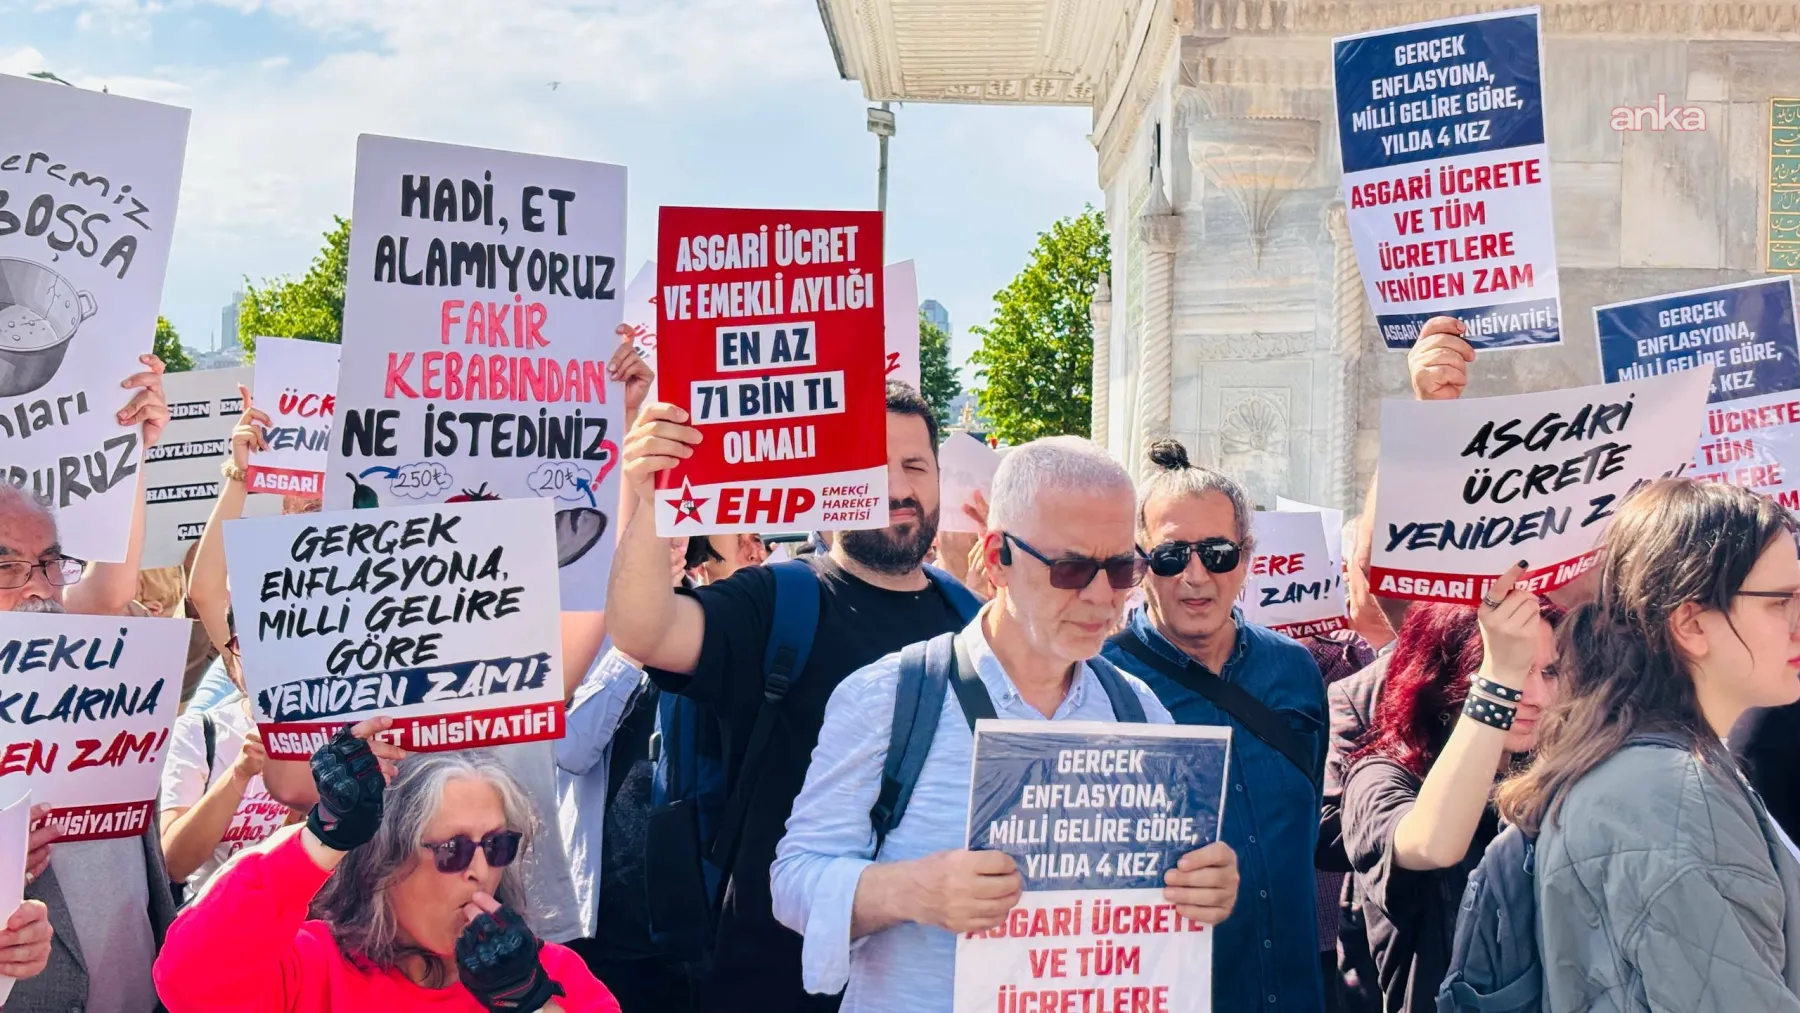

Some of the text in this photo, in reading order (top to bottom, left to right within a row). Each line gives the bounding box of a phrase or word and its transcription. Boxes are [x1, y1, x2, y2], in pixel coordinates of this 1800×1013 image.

[1394, 35, 1465, 67] GERÇEK
[1371, 62, 1495, 100] ENFLASYONA,
[1352, 86, 1524, 133] MİLLİ GELİRE GÖRE,
[1381, 119, 1491, 156] YILDA 4 KEZ
[401, 169, 576, 236] HADİ, ET
[1350, 158, 1541, 210] ASGARİ ÜCRETE
[1393, 196, 1486, 236] VE TÜM
[374, 234, 616, 300] ALAMIYORUZ
[675, 223, 859, 273] ASGARİ ÜCRET
[1378, 231, 1516, 271] ÜCRETLERE
[663, 268, 875, 321] VE EMEKLİ AYLIĞI
[1375, 263, 1534, 305] YENİDEN ZAM
[441, 293, 550, 349] FAKİR
[1658, 300, 1727, 328] GERÇEK
[721, 327, 810, 367] EN AZ
[1637, 321, 1756, 357] ENFLASYONA,
[1730, 341, 1783, 366] GÖRE,
[384, 351, 606, 404] KEBABINDAN
[1720, 370, 1755, 393] KEZ
[168, 401, 210, 419] İDEN
[696, 375, 839, 420] 71 BİN TL
[341, 408, 400, 457] NE
[1460, 392, 1636, 458] ASGARİ
[1708, 401, 1800, 436] ÜCRETE
[145, 440, 225, 461] KÖYLÜDEN
[723, 425, 816, 465] OLMALI
[1701, 437, 1755, 466] TÜM
[253, 472, 318, 493] ASGARİ
[822, 482, 869, 498] EMEKÇİ
[1462, 443, 1633, 504] ÜCRETE
[146, 484, 219, 502] HALKTAN
[715, 487, 816, 525] EHP
[822, 497, 880, 510] HAREKET
[822, 508, 871, 522] PARTİSİ
[1385, 506, 1572, 553] YENİDEN
[1379, 575, 1472, 600] ASGARİ
[258, 586, 525, 642] MİLLİ GELİRE
[326, 632, 443, 675] GÖRE
[267, 661, 541, 719] YENİDEN ZAM!
[412, 706, 556, 747] İNİSİYATİFİ
[67, 727, 169, 773] ZAM!
[1057, 749, 1145, 777] GERÇEK
[1022, 783, 1173, 811] ENFLASYONA,
[989, 814, 1199, 845] MİLLİ GELİRE GÖRE,
[1025, 852, 1158, 879] YILDA 4 KEZ
[1029, 940, 1141, 978] VE TÜM
[997, 985, 1169, 1013] ÜCRETLERE
